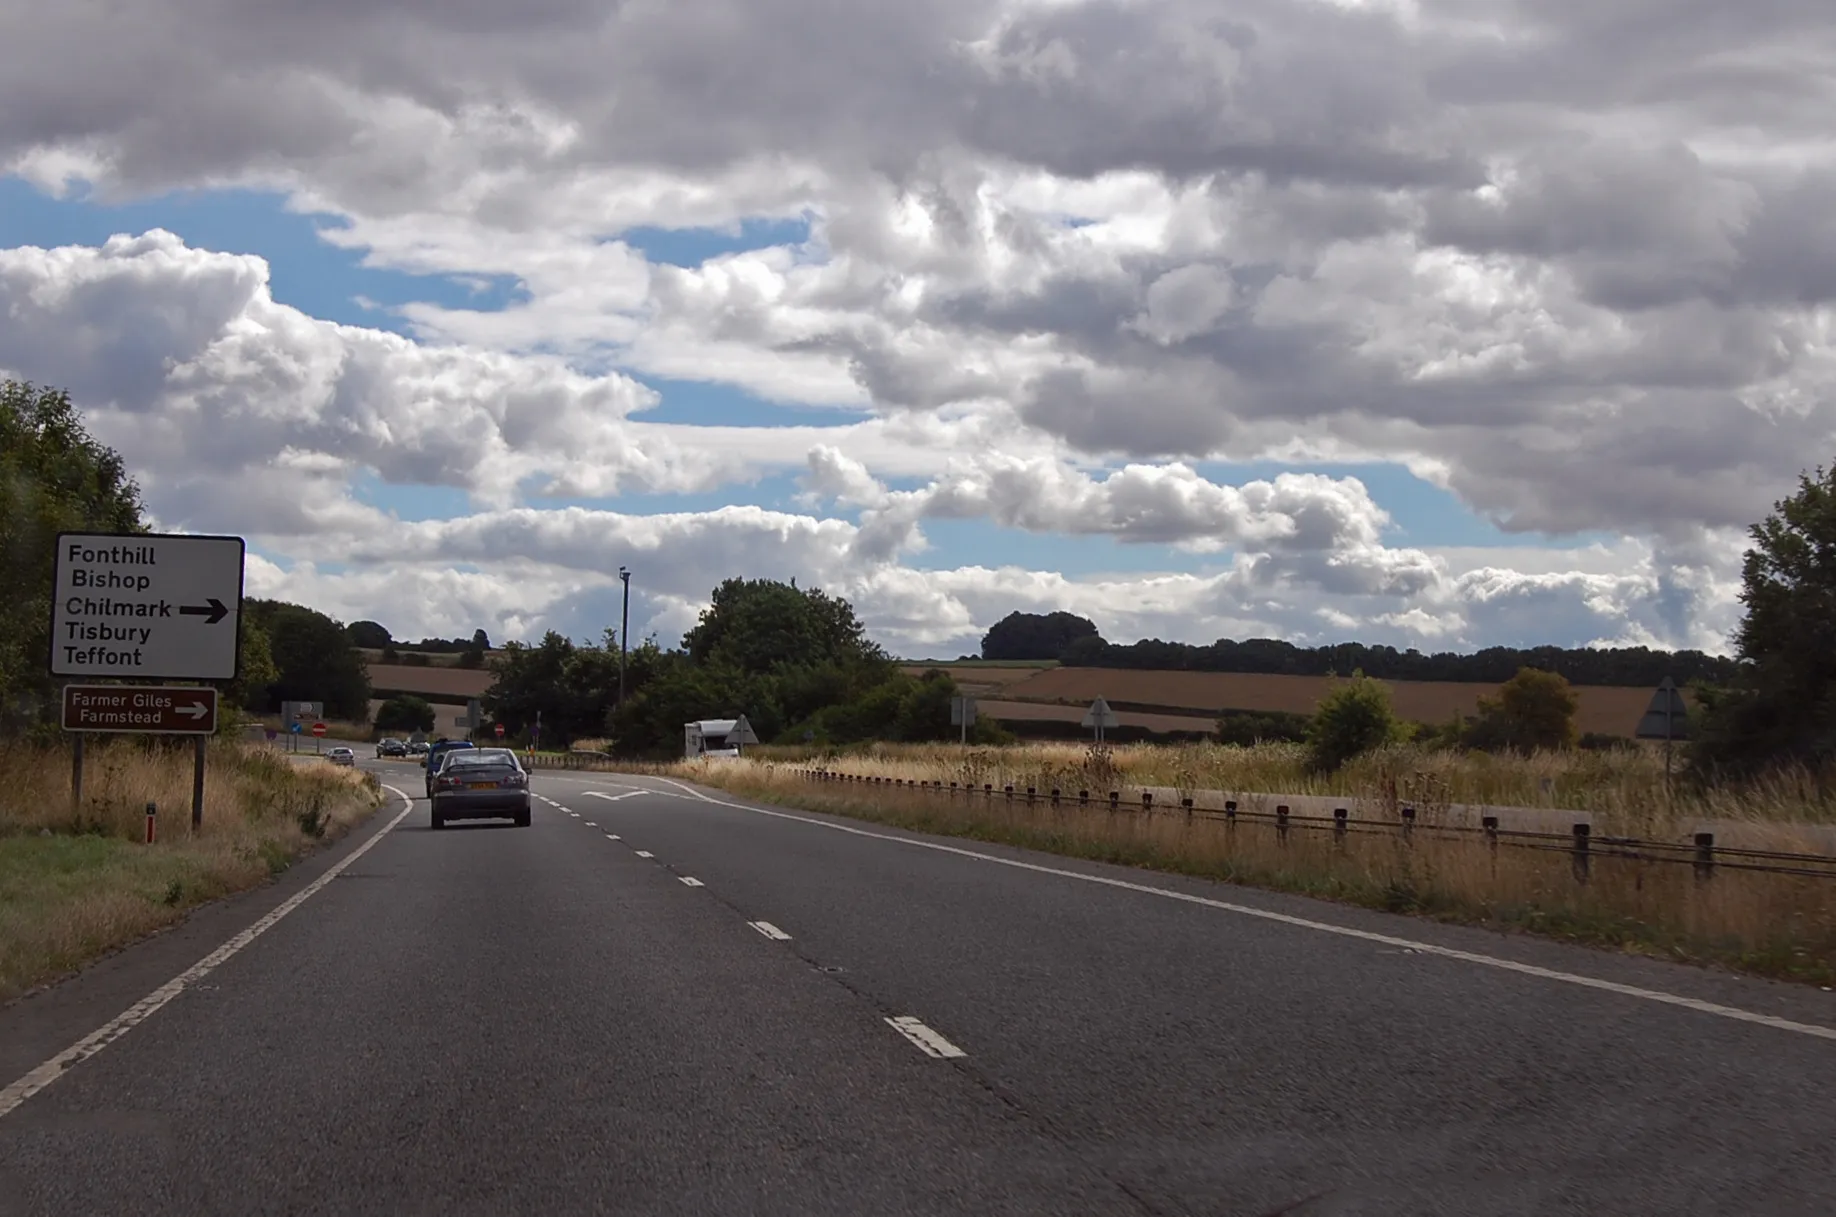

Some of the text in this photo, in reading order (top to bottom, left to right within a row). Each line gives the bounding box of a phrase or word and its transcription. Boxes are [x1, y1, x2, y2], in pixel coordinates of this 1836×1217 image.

[68, 545, 155, 565] Fonthill
[72, 569, 150, 592] Bishop
[66, 597, 172, 617] Chilmark
[65, 621, 151, 645] Tisbury
[63, 646, 142, 665] Teffont
[72, 692, 172, 707] Farmer Giles
[80, 709, 162, 724] Farmstead
